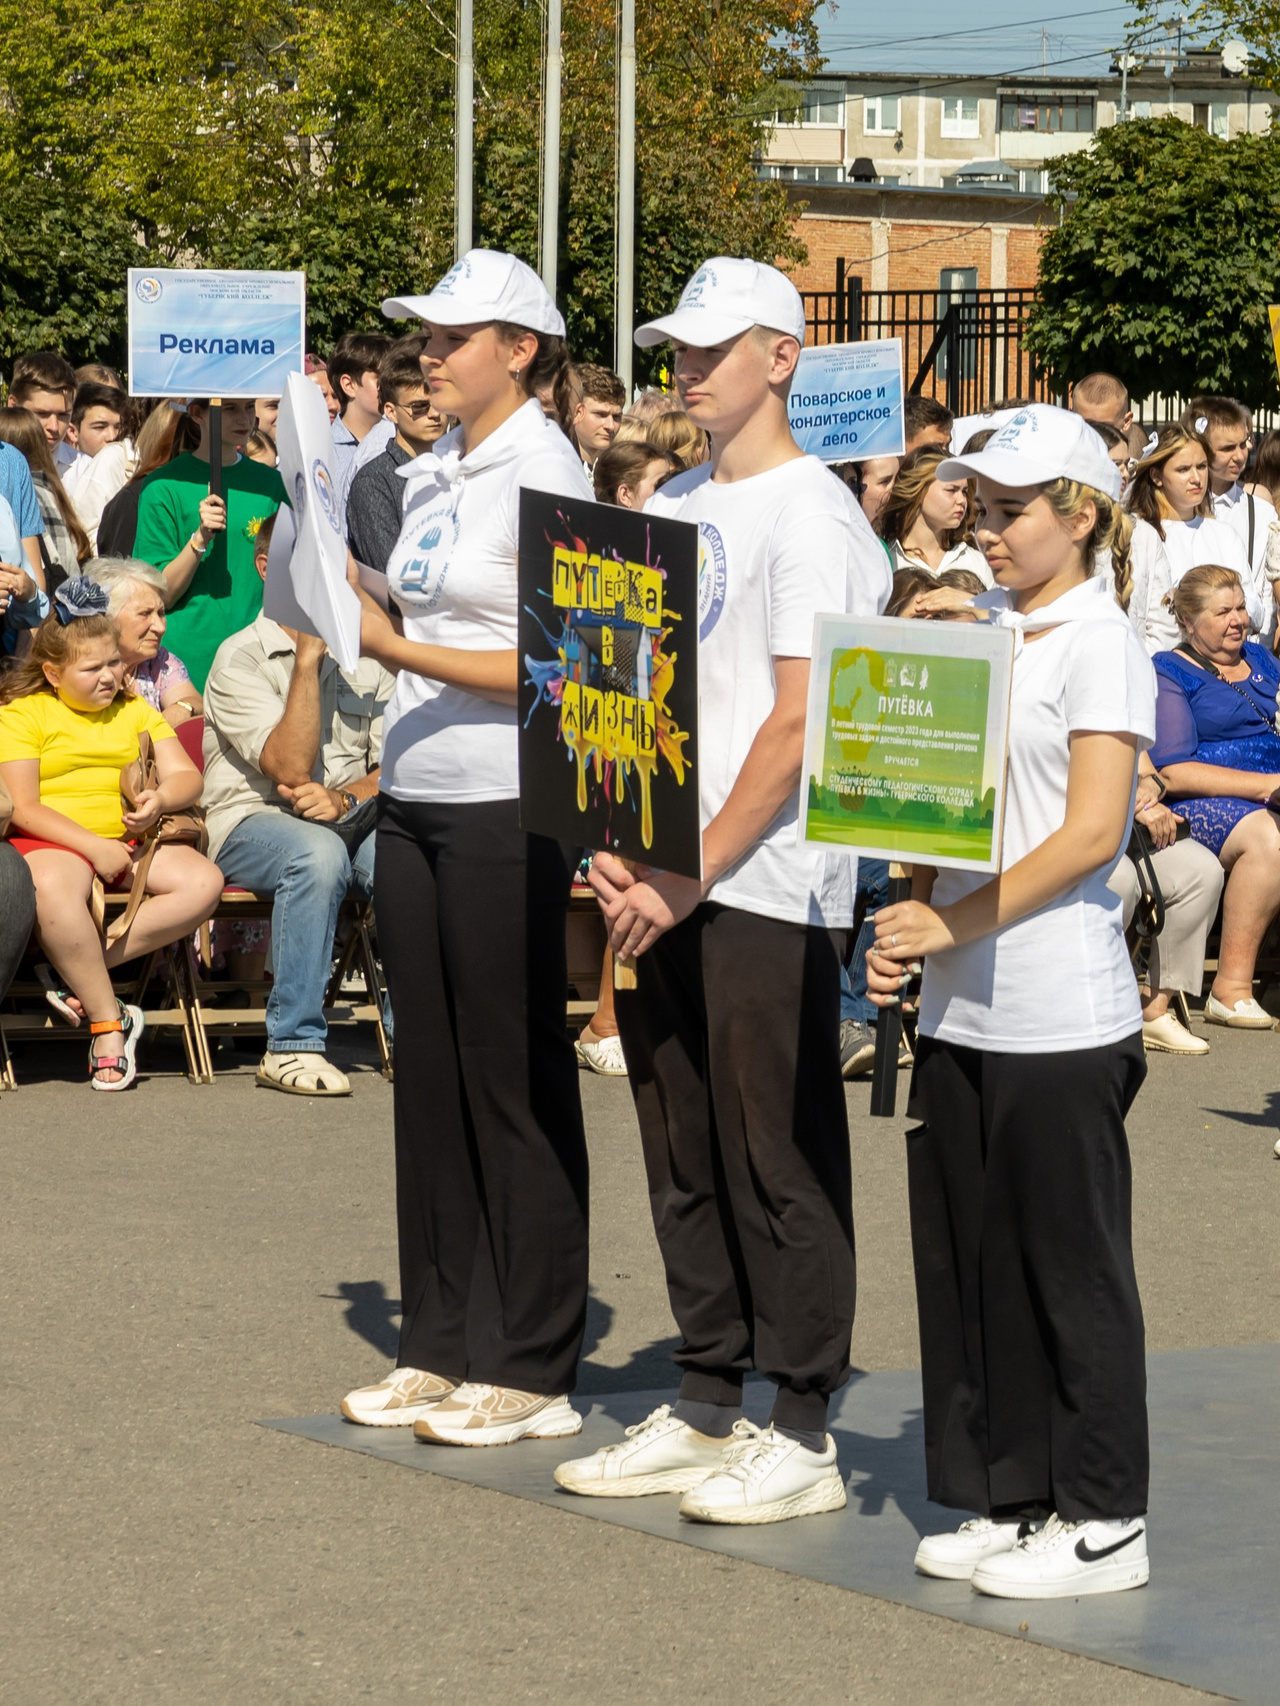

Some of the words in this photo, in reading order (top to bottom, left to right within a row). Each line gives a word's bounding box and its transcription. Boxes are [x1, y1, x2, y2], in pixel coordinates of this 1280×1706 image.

[160, 333, 275, 355] Реклама
[791, 388, 872, 408] Поварское
[876, 386, 886, 398] и
[789, 406, 891, 430] кондитерское
[821, 432, 858, 447] дело
[705, 526, 726, 602] КОЛЛЕДЖ
[877, 694, 934, 718] ПУТЁВКА
[563, 692, 657, 752] ЖИЗНЬ
[836, 720, 855, 730] летний
[856, 721, 881, 732] трудовой
[881, 724, 905, 735] семестр
[905, 724, 919, 735] 2023
[919, 727, 933, 738] года
[933, 729, 944, 739] для
[944, 731, 980, 741] выполнения
[832, 731, 858, 741] трудовых
[858, 733, 875, 744] задач
[880, 735, 912, 746] достойного
[912, 739, 955, 750] представления
[954, 743, 978, 753] региона
[884, 755, 919, 767] ВРУЧАЕТСЯ
[829, 774, 883, 788] СТУДЕНЧЕСКОМУ
[883, 779, 948, 795] ПЕДАГОГИЧЕСКОМУ
[948, 786, 974, 798] ОТРЯДУ
[857, 785, 862, 796] В
[890, 790, 935, 803] ГУБЕРНСКОГО
[936, 794, 974, 808] КОЛЛЕДЖА
